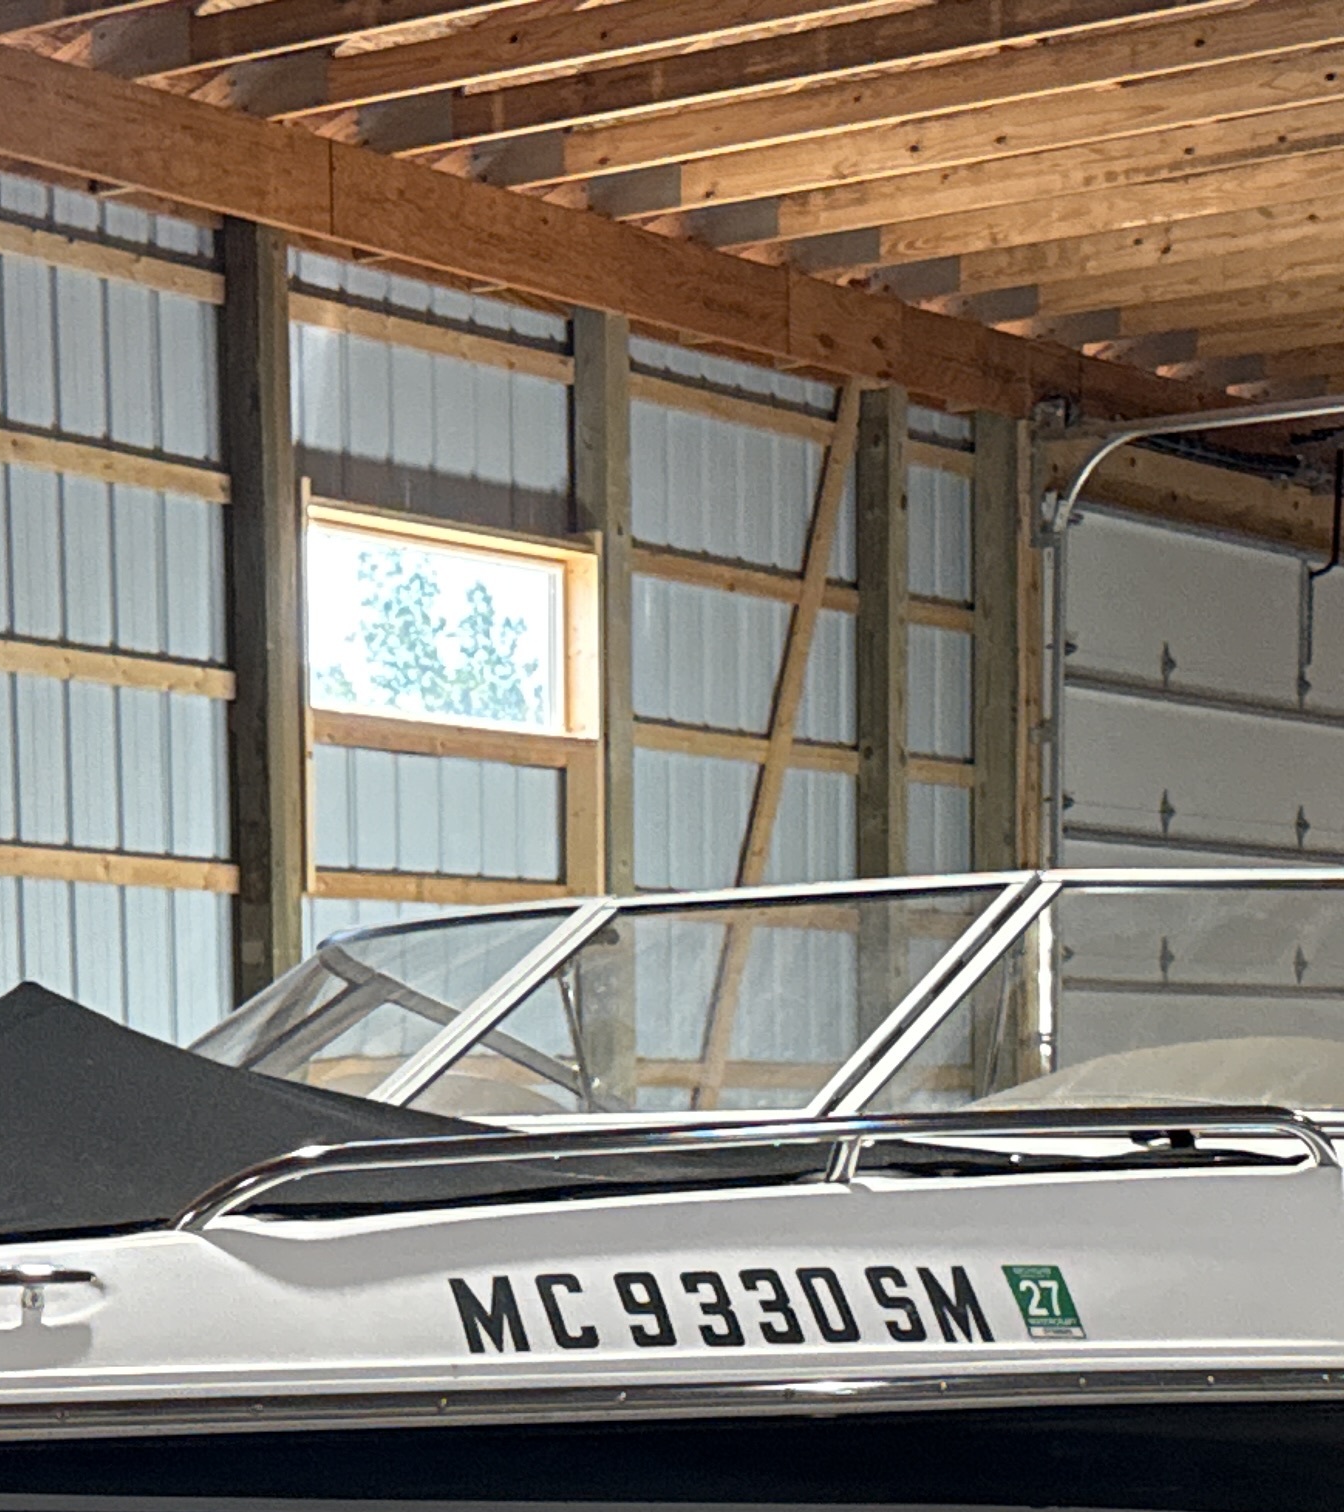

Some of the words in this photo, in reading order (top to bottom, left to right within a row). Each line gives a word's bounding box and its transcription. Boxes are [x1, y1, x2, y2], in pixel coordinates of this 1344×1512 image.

[448, 1273, 600, 1354] MC
[613, 1267, 862, 1347] 9330
[864, 1265, 995, 1343] SM
[1019, 1279, 1061, 1316] 27
